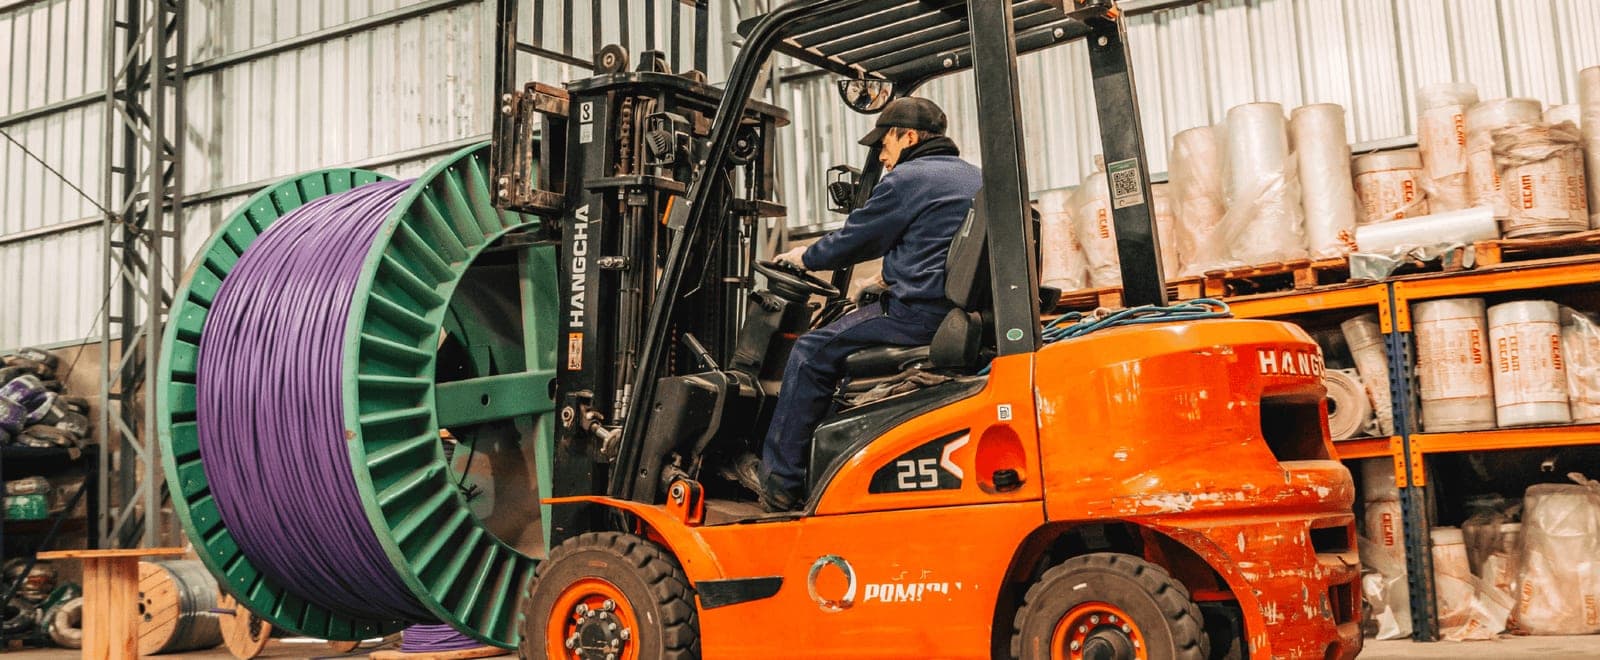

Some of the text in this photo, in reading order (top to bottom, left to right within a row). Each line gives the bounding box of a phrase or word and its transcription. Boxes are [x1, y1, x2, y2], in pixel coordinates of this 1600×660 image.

[1521, 174, 1533, 209] CECAM
[1098, 208, 1110, 239] CECAM
[570, 204, 589, 328] HANGCHA
[1471, 330, 1482, 364] CECAM
[1499, 338, 1510, 373] CECAM
[1510, 336, 1520, 371] CECAM
[1551, 335, 1562, 370] CECAM
[897, 458, 938, 489] 25
[1383, 513, 1394, 546] CECAM
